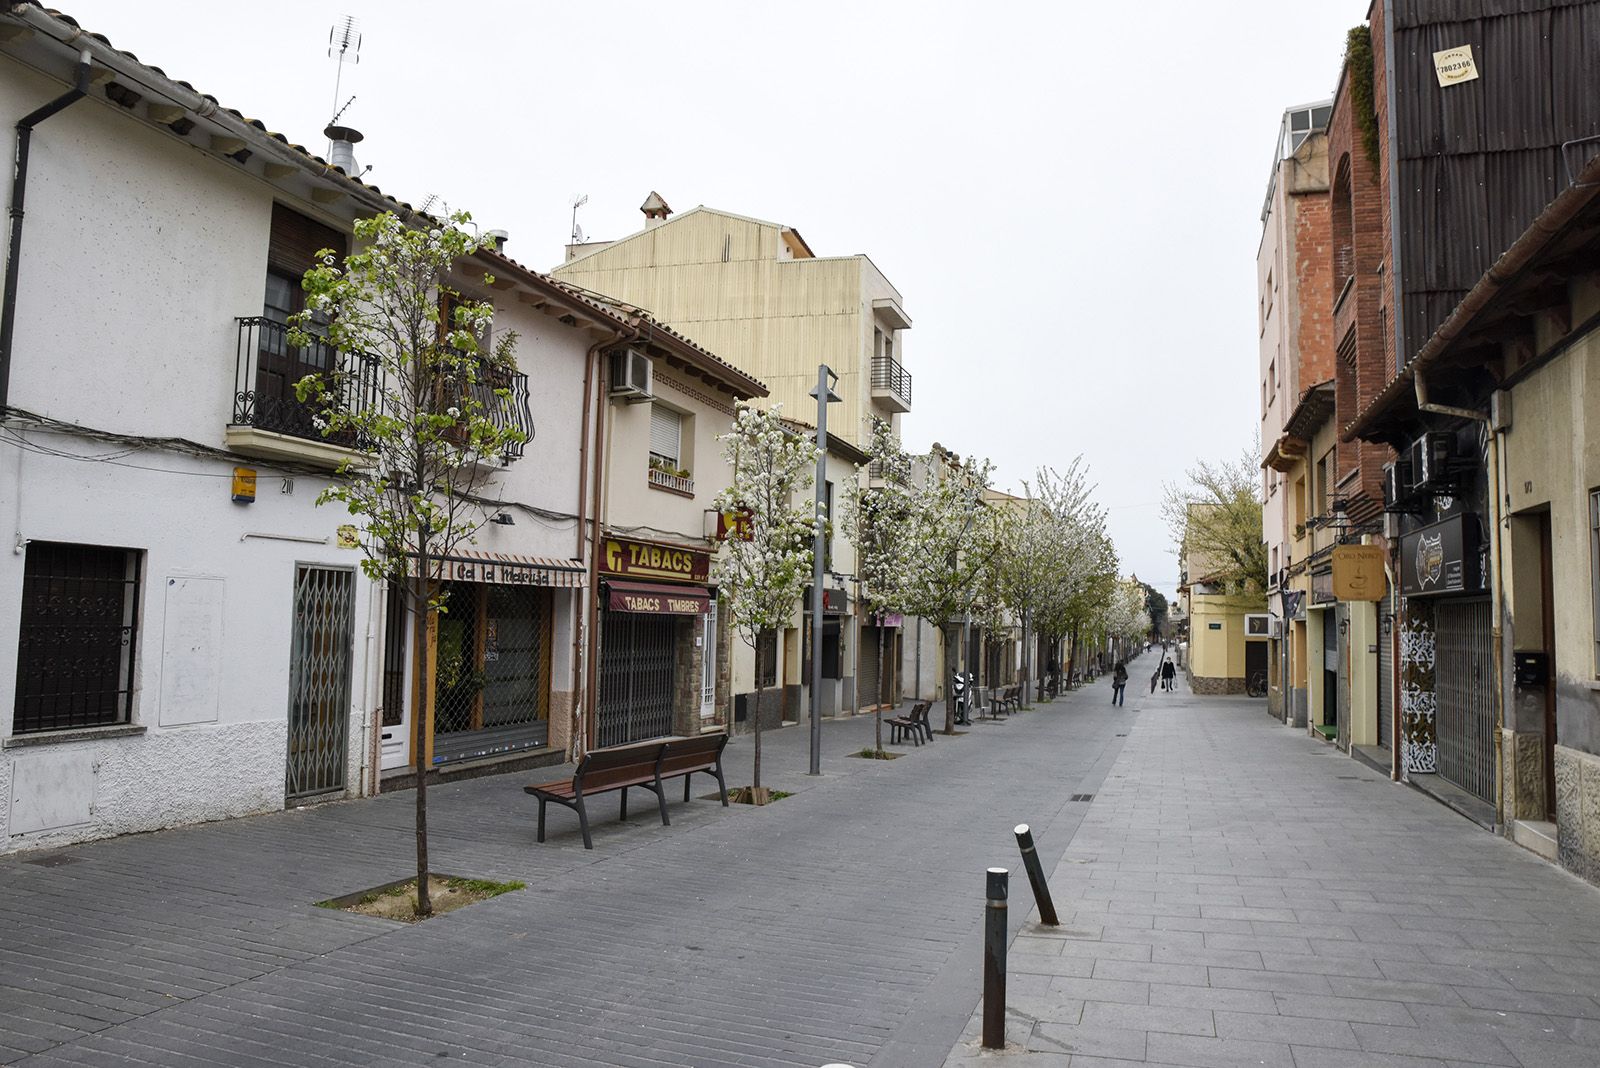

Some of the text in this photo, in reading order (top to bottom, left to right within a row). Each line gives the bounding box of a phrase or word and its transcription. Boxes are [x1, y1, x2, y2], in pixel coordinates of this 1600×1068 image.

[1440, 60, 1471, 73] 7802366
[281, 478, 294, 495] 210
[629, 544, 692, 573] TABACS
[457, 564, 549, 586] Ca la Maruja
[625, 596, 700, 612] TABACS TIMBRES
